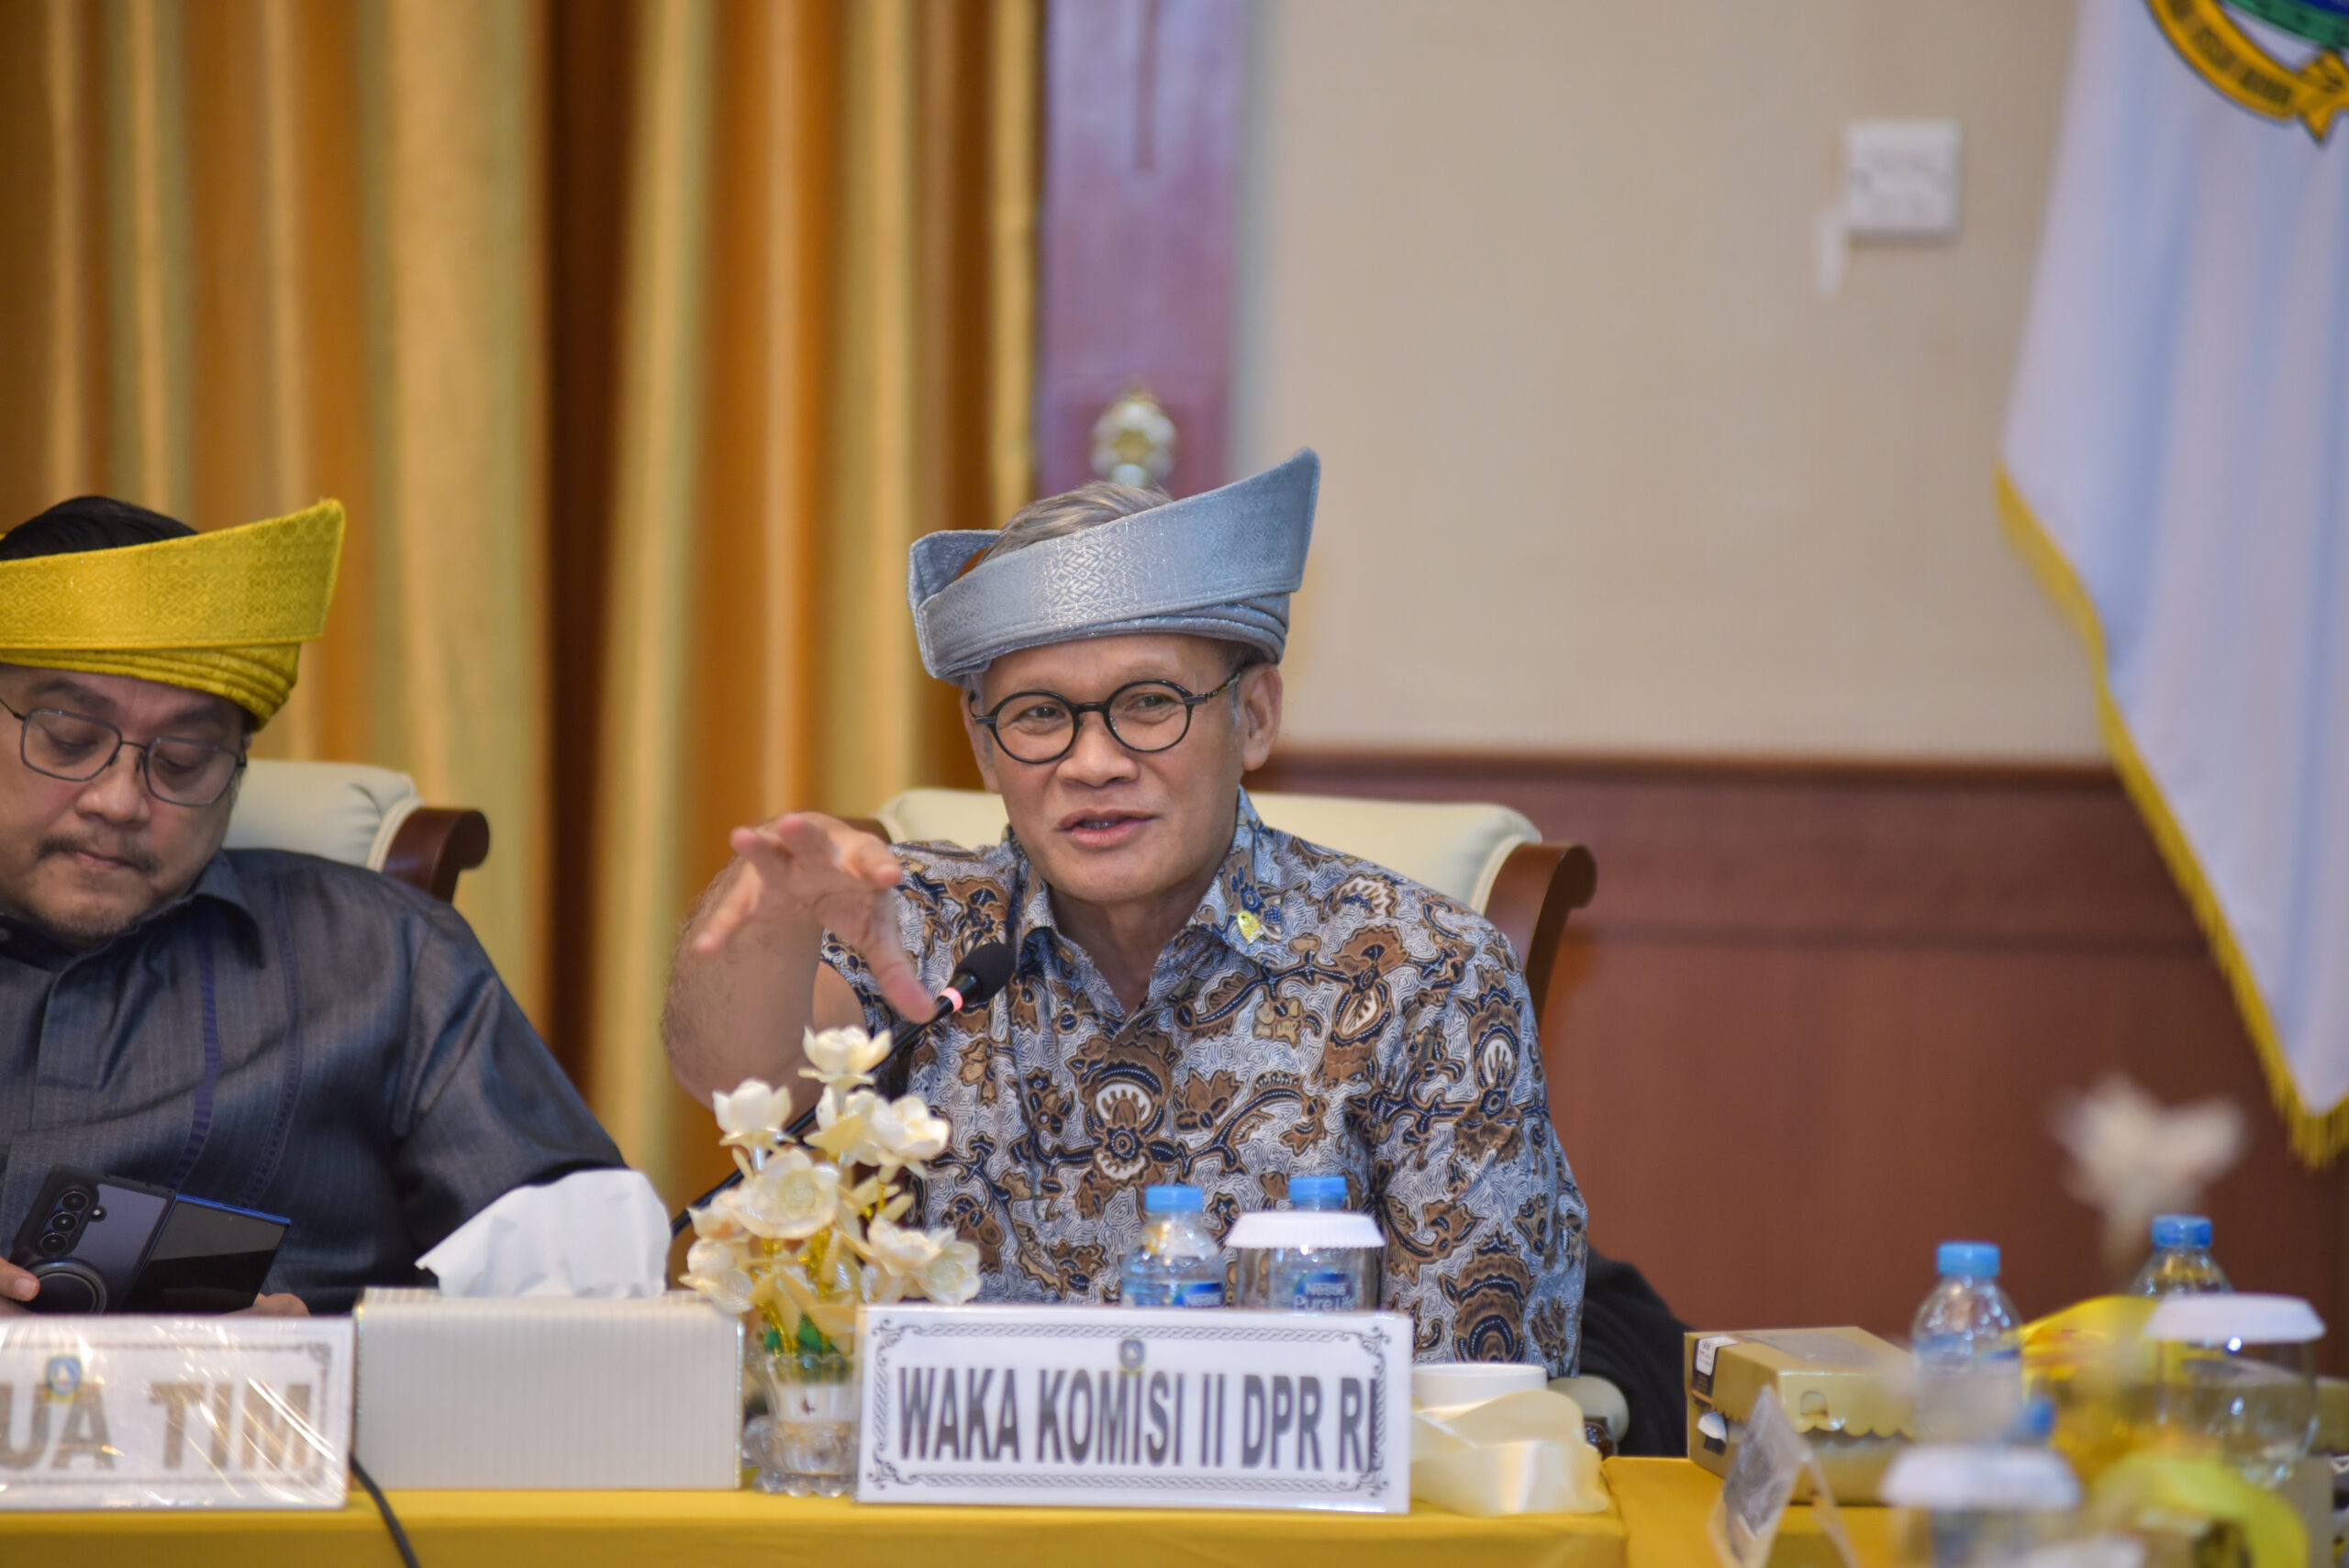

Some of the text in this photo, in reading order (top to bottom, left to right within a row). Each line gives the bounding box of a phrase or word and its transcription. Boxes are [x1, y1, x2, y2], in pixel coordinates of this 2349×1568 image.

[1294, 1295, 1333, 1311] Pure
[150, 1382, 312, 1470] TIM
[898, 1367, 1378, 1472] WAKA KOMISI II DPR RI
